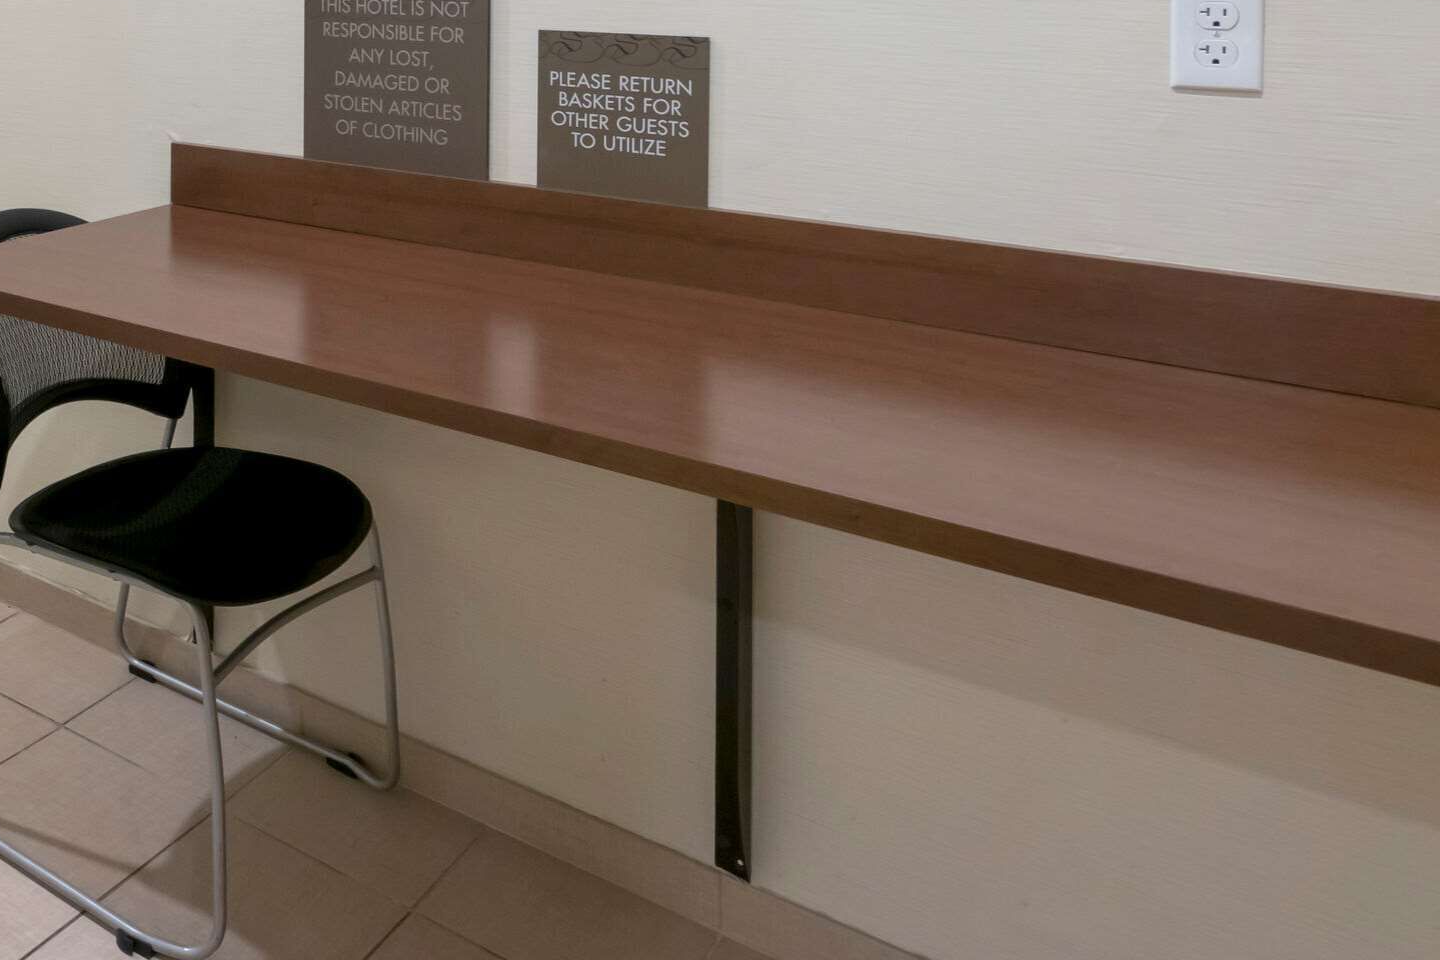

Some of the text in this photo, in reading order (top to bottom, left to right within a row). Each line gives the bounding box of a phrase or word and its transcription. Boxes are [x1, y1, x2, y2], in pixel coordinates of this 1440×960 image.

[411, 0, 425, 16] IS
[430, 1, 470, 18] NOT
[323, 21, 464, 44] RESPONSIBLE FOR
[348, 48, 433, 70] ANY LOST,
[335, 70, 450, 94] DAMAGED OR
[550, 71, 692, 96] PLEASE RETURN
[324, 93, 462, 121] STOLEN ARTICLES
[559, 91, 682, 116] BASKETS FOR
[335, 119, 448, 145] OF CLOTHING
[551, 110, 689, 138] OTHER GUESTS
[571, 132, 666, 156] TO UTILIZE
